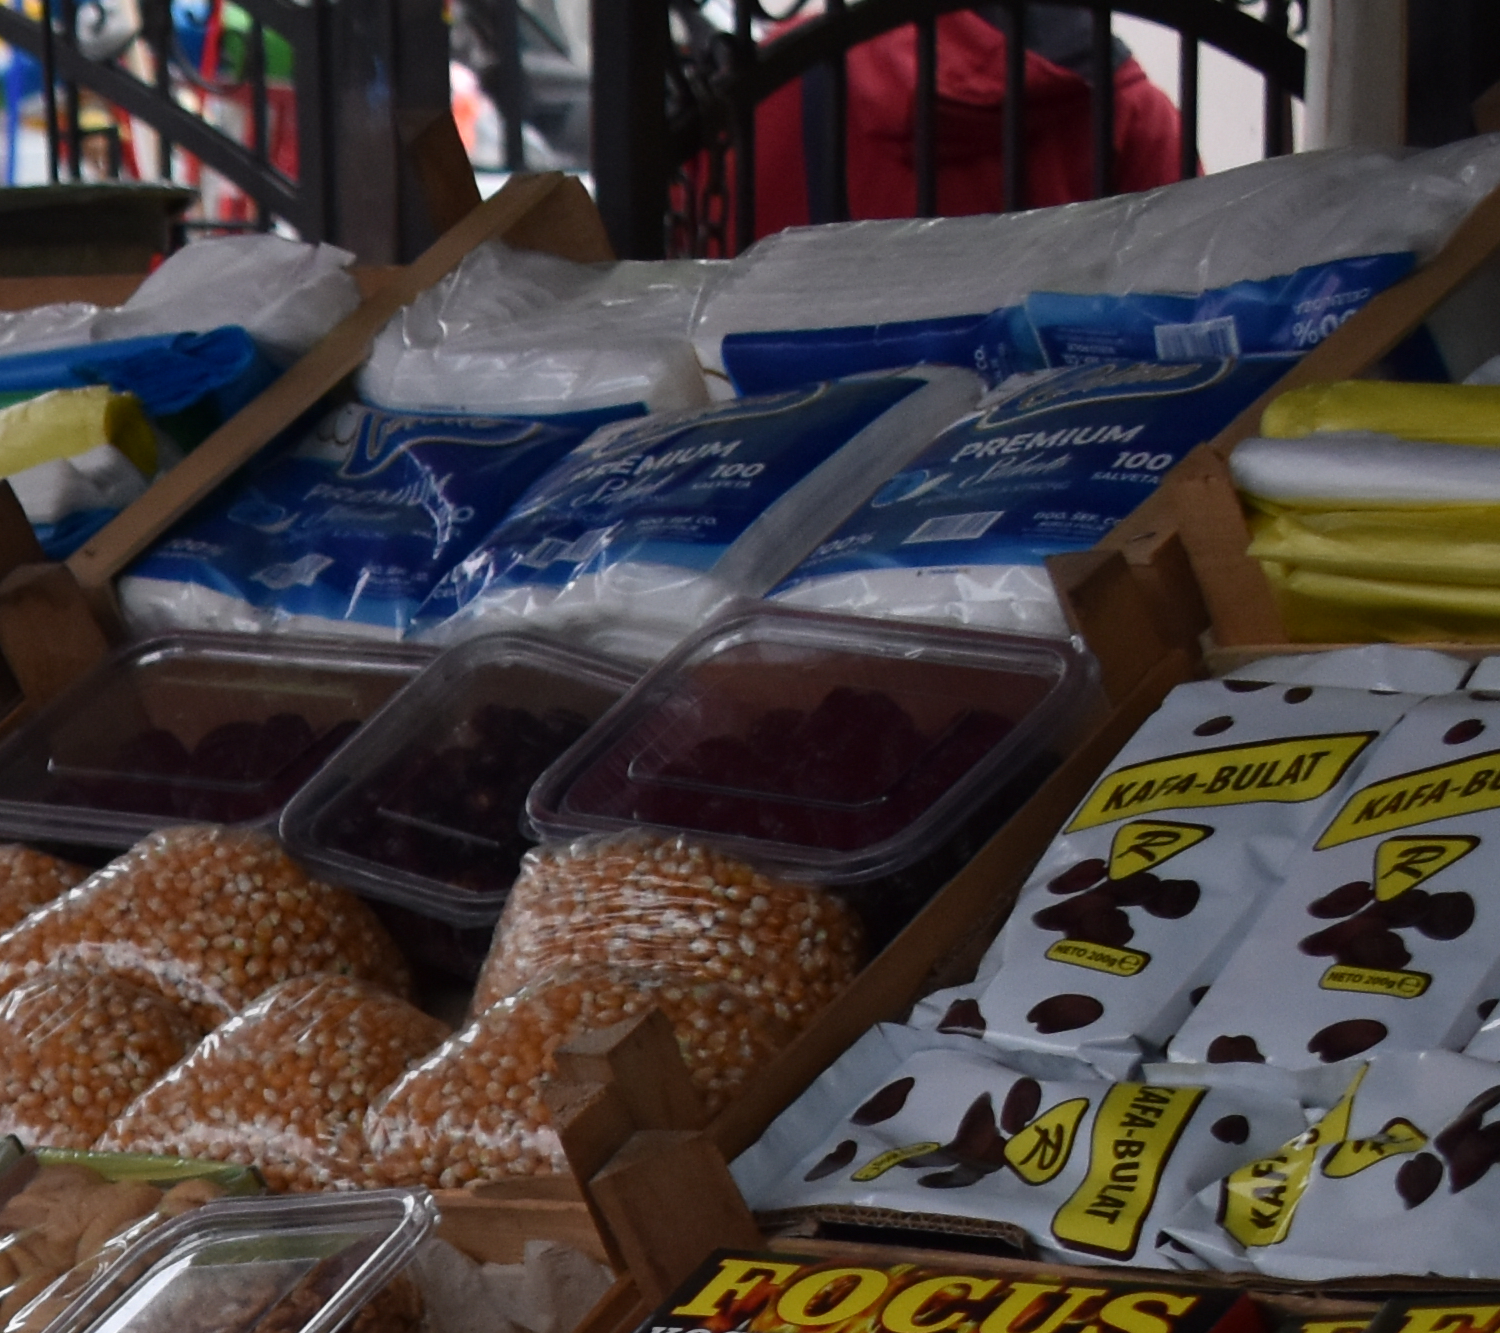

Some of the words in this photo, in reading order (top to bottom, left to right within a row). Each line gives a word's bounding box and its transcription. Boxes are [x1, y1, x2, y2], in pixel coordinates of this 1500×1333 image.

[950, 424, 1146, 463] PREMIUM
[569, 440, 742, 483] PREMIUM
[709, 463, 766, 479] 100
[1111, 451, 1174, 471] 100
[1100, 751, 1330, 814] KAFA-BULAT
[1054, 941, 1087, 958] NETO
[1088, 949, 1118, 968] 200g
[1327, 971, 1360, 984] NETO
[1362, 973, 1396, 990] 200g
[1084, 1085, 1174, 1227] AFA-BULAT
